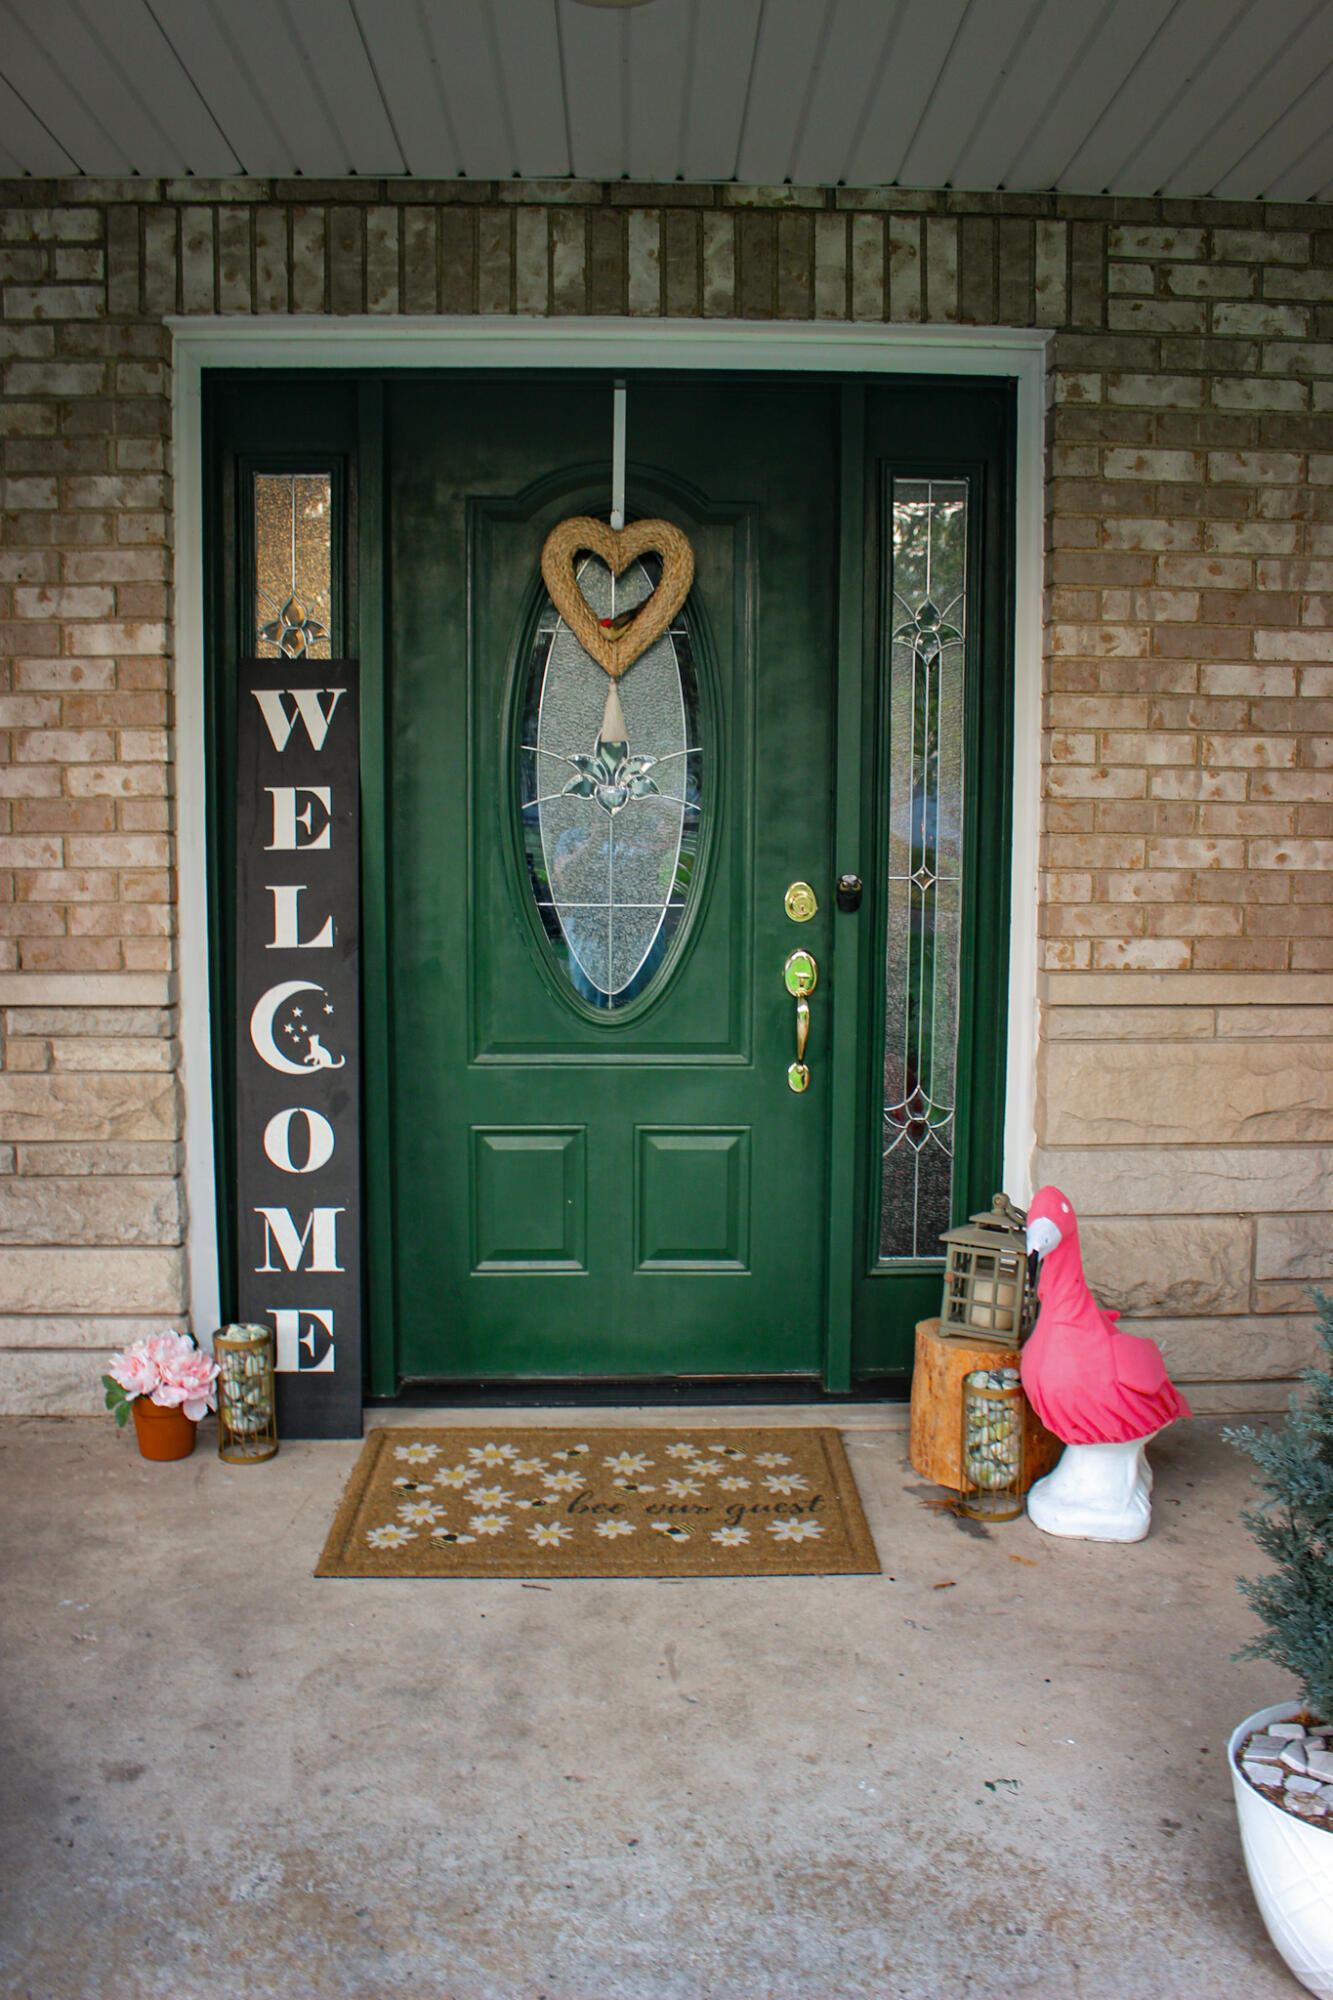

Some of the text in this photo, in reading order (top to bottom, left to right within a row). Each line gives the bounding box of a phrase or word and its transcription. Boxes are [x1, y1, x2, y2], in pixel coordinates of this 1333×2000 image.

[250, 688, 347, 1373] WELCOME
[566, 1489, 827, 1526] bee our guest
